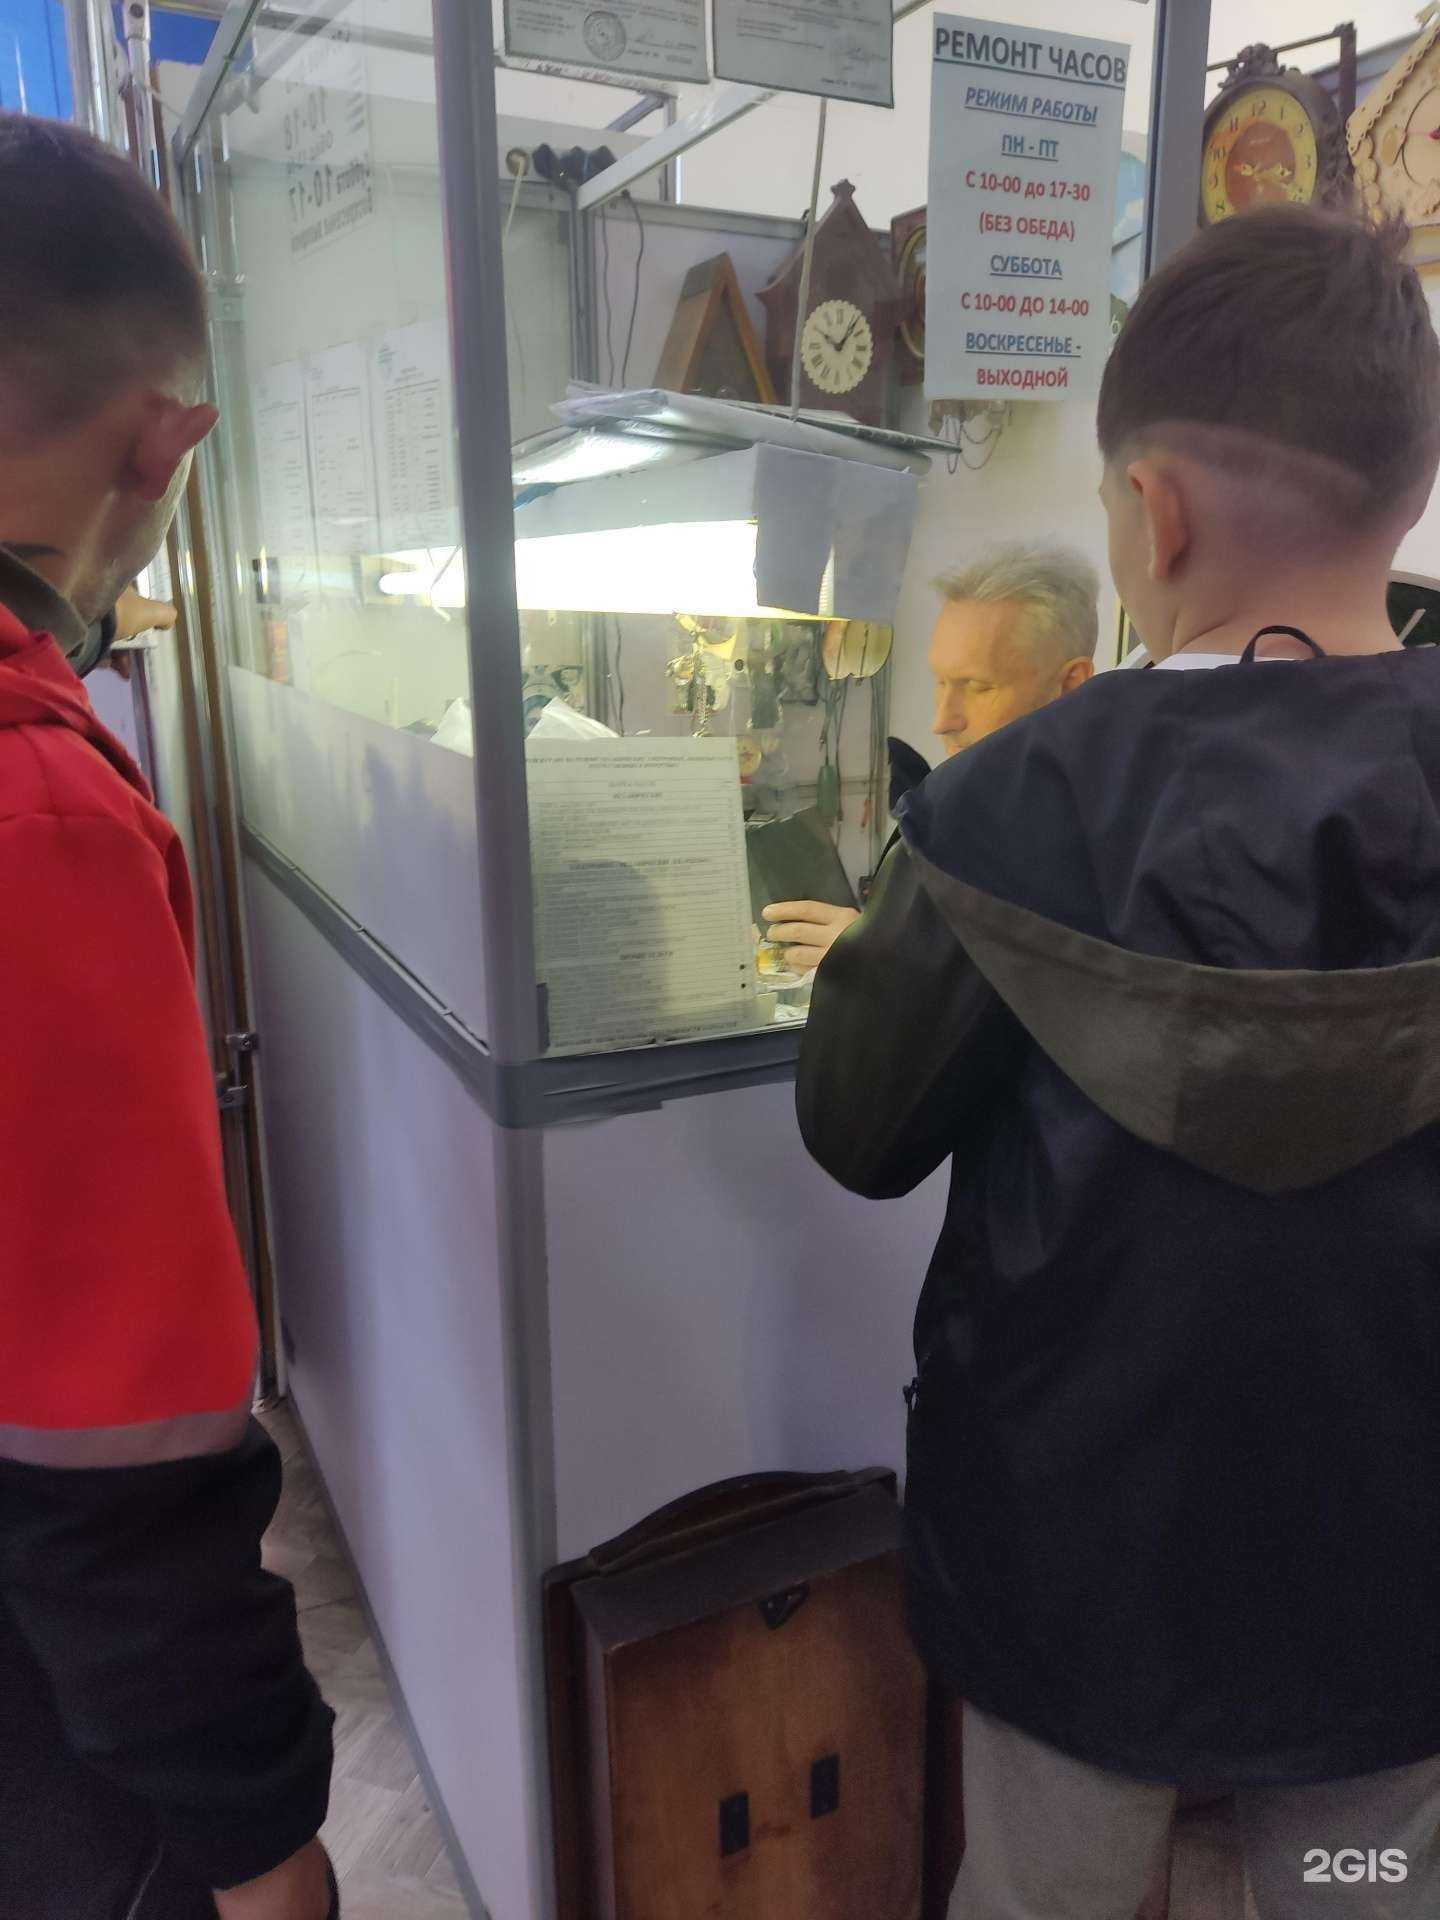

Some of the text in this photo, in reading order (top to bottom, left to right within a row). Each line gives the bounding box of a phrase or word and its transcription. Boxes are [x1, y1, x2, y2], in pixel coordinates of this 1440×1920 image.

[935, 27, 1126, 83] РЕМОНТ ЧАСОВ
[965, 87, 1098, 123] РЕЖИМ РАБОТЫ
[1001, 134, 1024, 154] ПН
[1039, 139, 1059, 158] ПТ
[965, 170, 1090, 201] С 10-00 до 17-30
[979, 211, 1075, 241] (БЕЗ ОБЕДА)
[990, 254, 1062, 275] СУББОТА
[961, 292, 1089, 316] С 10-00 ДО 14-00
[966, 332, 1072, 354] ВОСКРЕСЕНЬЕ
[976, 367, 1068, 390] ВЫХОДНОЙ
